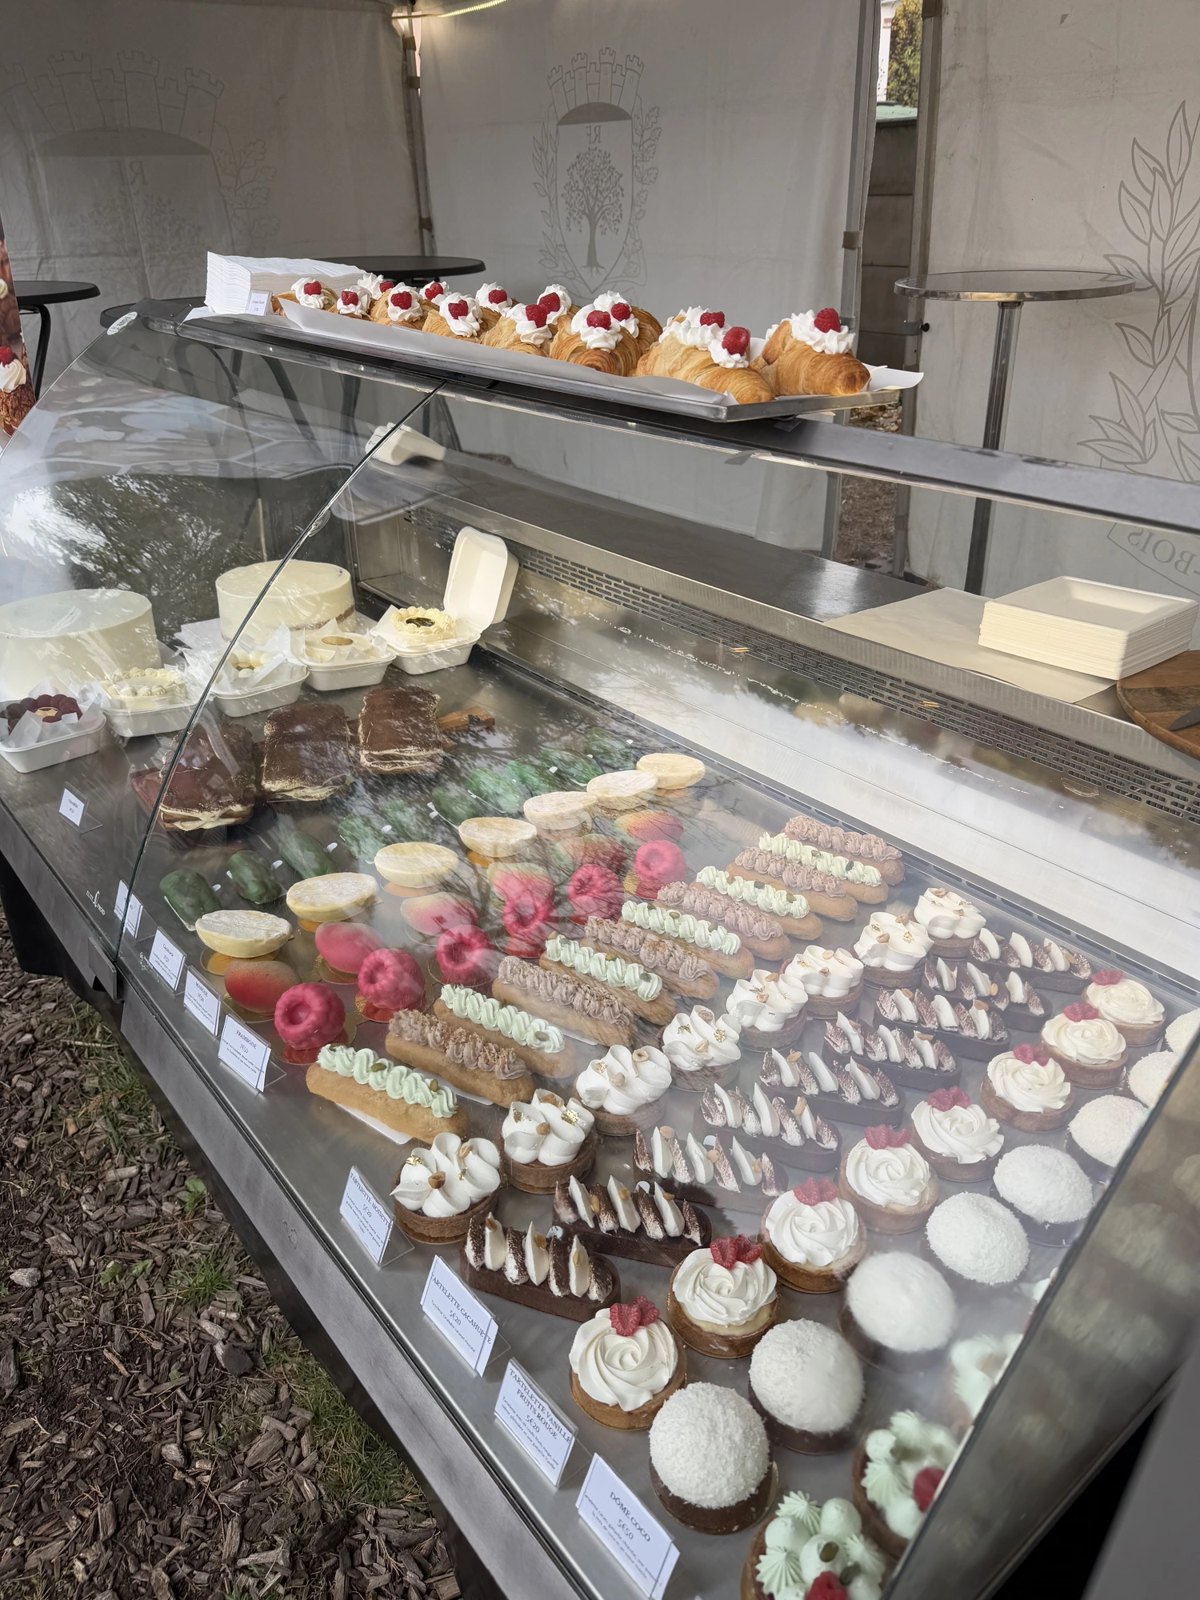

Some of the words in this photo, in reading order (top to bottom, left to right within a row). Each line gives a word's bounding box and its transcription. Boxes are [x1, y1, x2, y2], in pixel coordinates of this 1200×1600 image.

[509, 1368, 546, 1415] TARTELETTE
[516, 1388, 537, 1415] FRUITS
[630, 1516, 651, 1542] COCO
